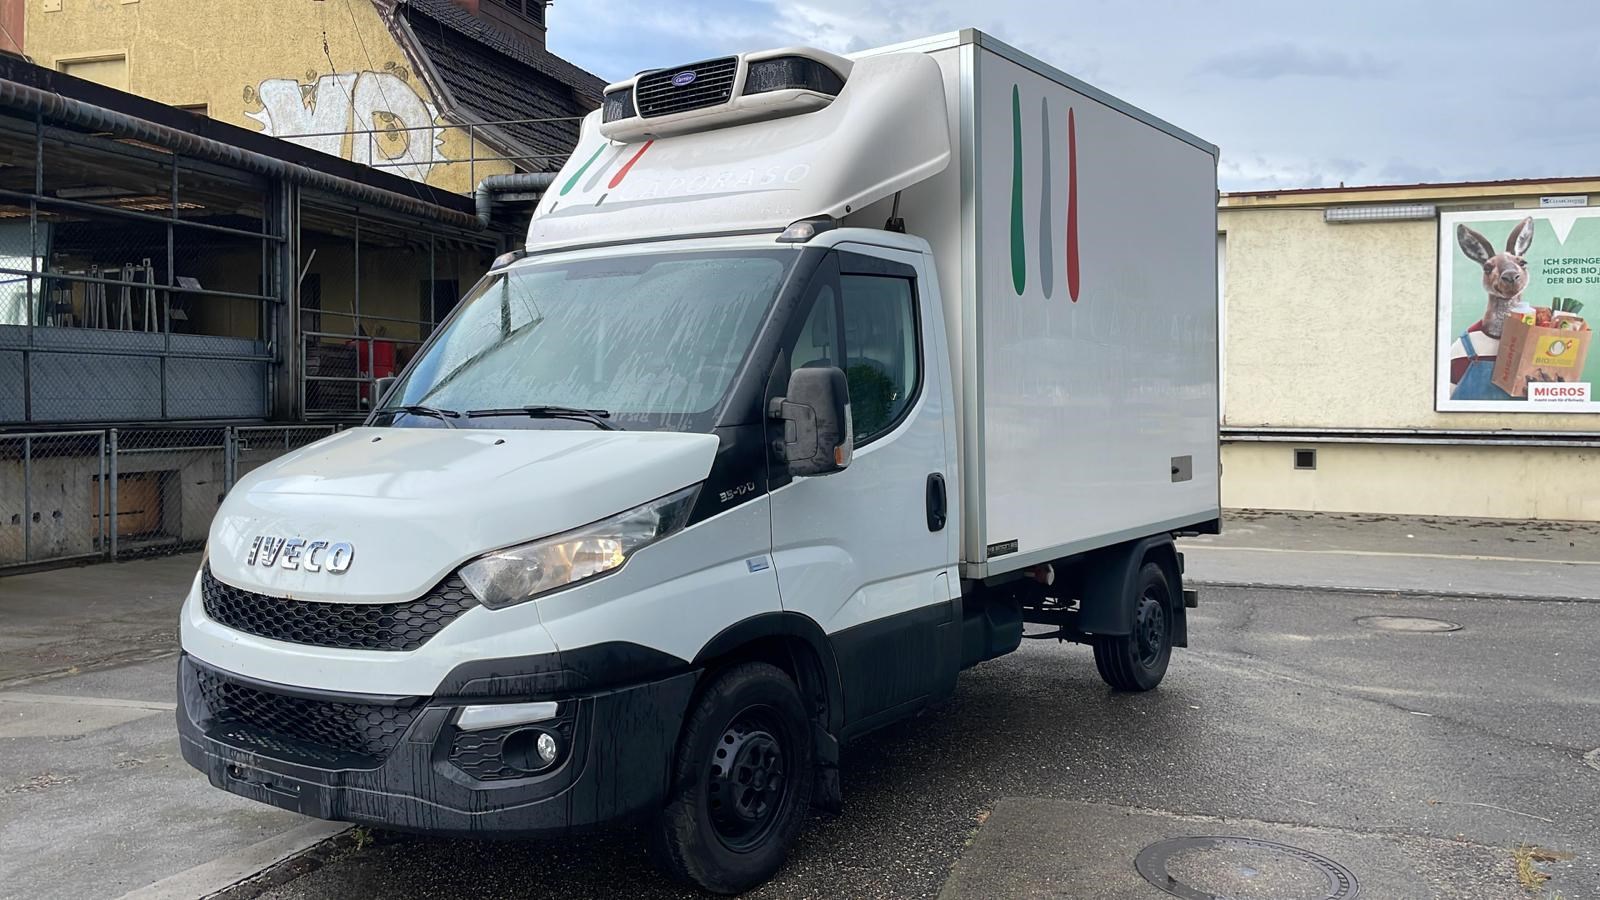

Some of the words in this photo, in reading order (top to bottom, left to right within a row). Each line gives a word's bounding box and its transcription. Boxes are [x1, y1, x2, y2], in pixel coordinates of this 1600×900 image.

[1562, 257, 1600, 265] SPRINGE
[1542, 267, 1578, 275] MIGROS
[1585, 276, 1600, 284] SUI
[1534, 387, 1585, 396] MIGROS
[247, 535, 355, 576] IVECO
